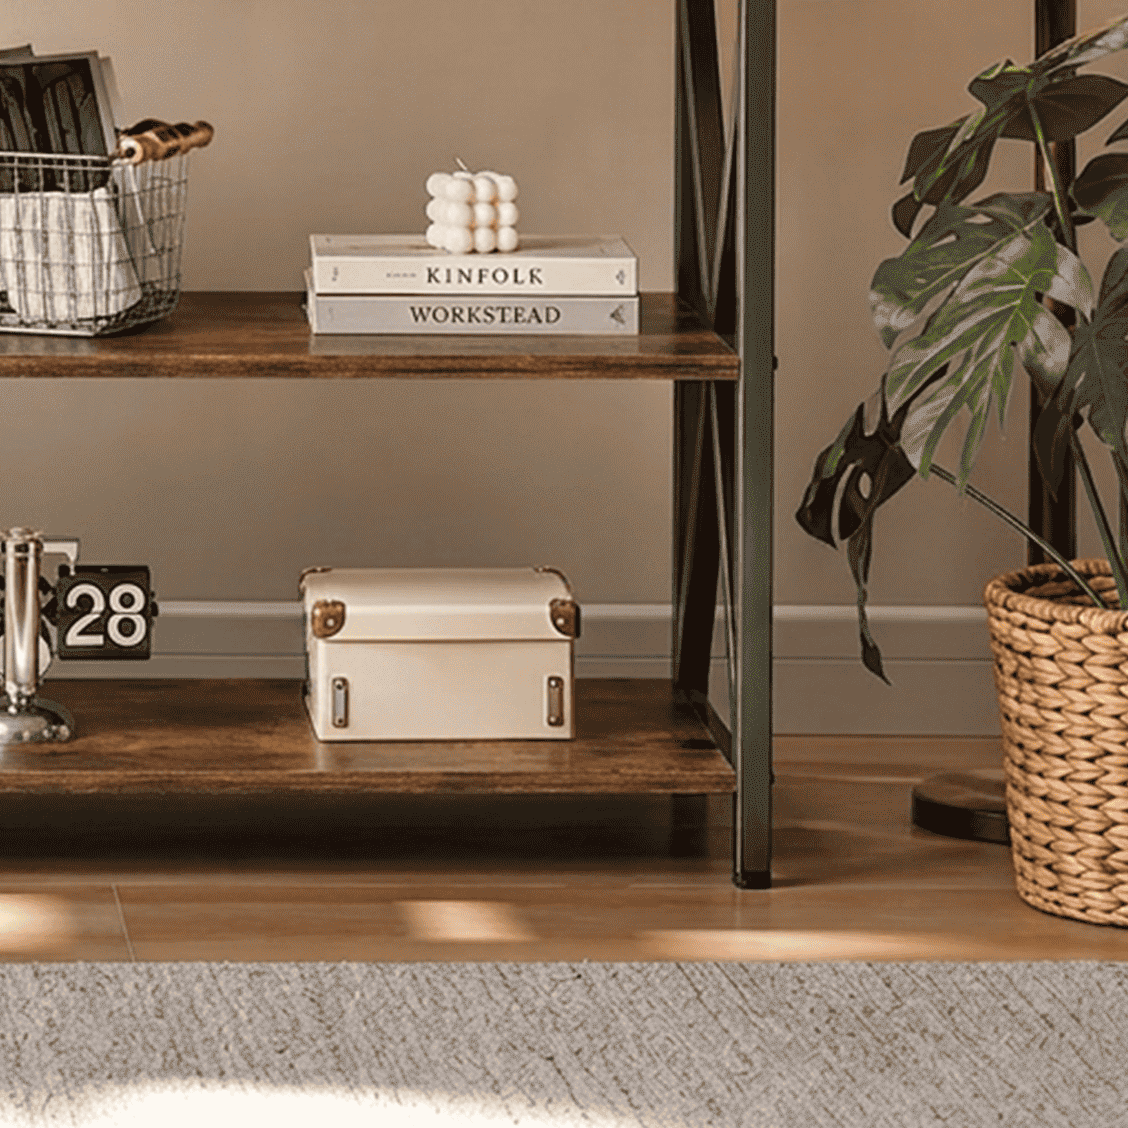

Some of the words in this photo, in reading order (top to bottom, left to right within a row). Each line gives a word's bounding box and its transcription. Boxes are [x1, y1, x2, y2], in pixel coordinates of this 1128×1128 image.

[426, 267, 543, 284] KINFOLK
[410, 306, 561, 323] WORKSTEAD
[66, 583, 147, 647] 28
